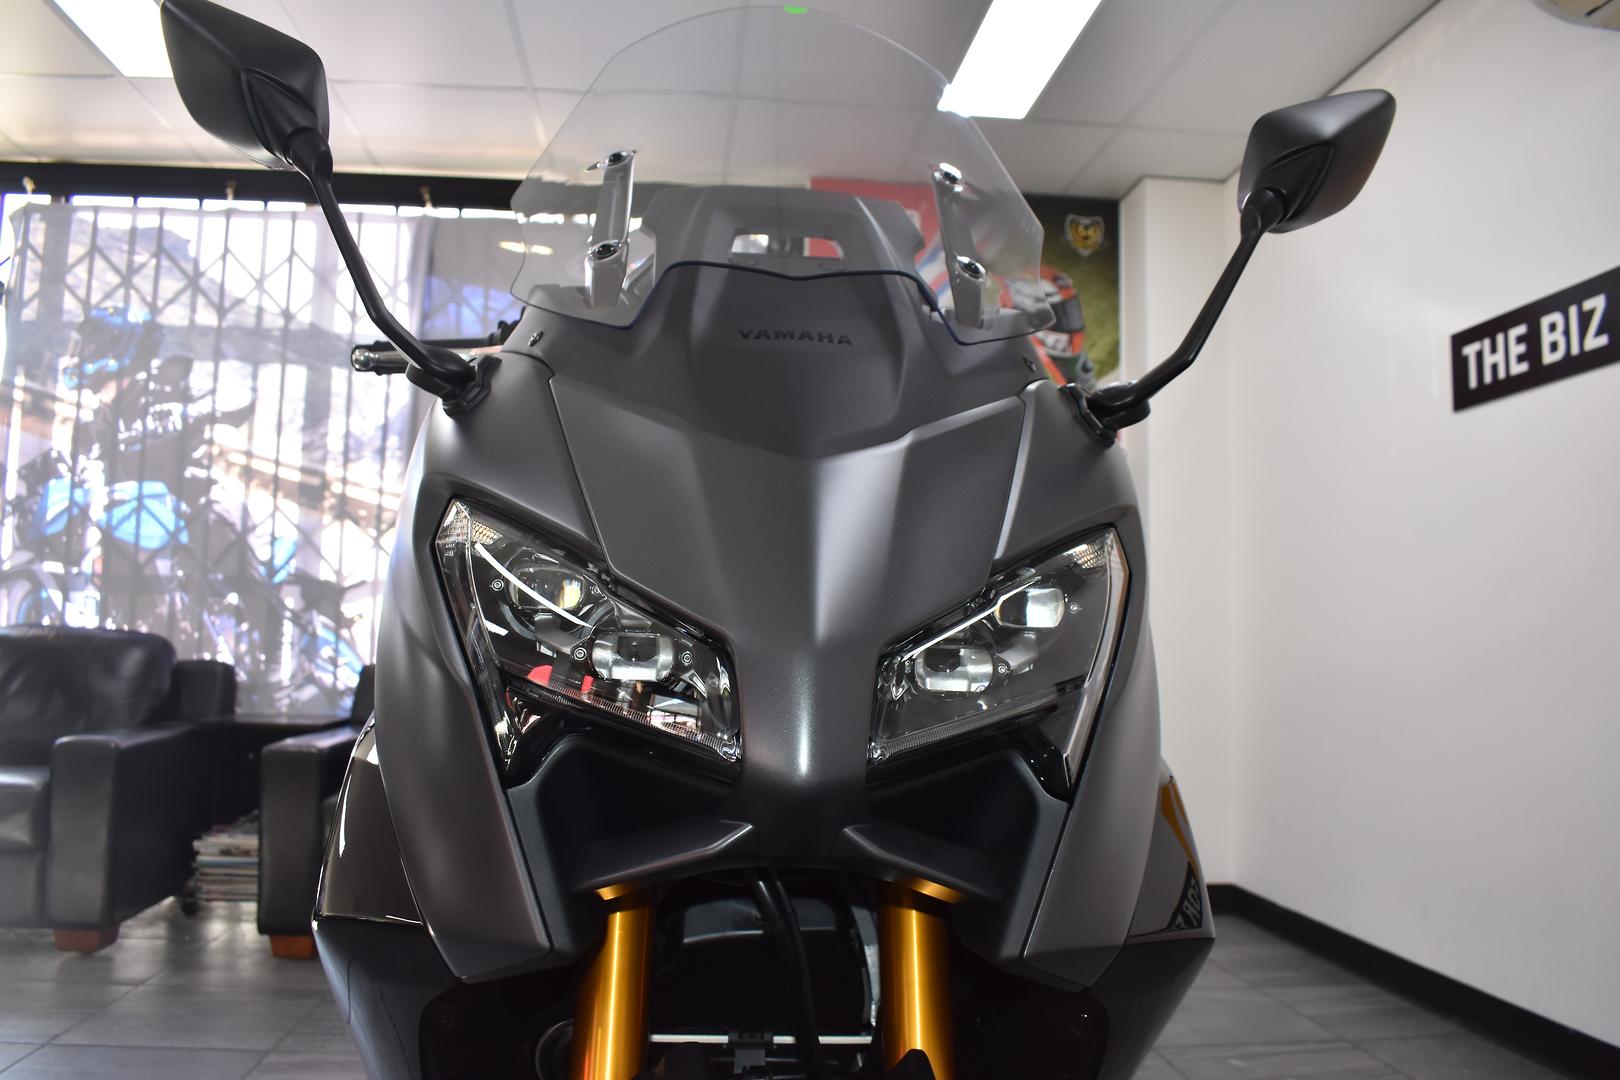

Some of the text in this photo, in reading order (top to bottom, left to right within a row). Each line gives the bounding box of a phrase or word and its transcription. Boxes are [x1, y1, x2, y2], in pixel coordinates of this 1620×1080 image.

[738, 328, 855, 347] YAMAHA
[1461, 293, 1609, 390] THE BIZ
